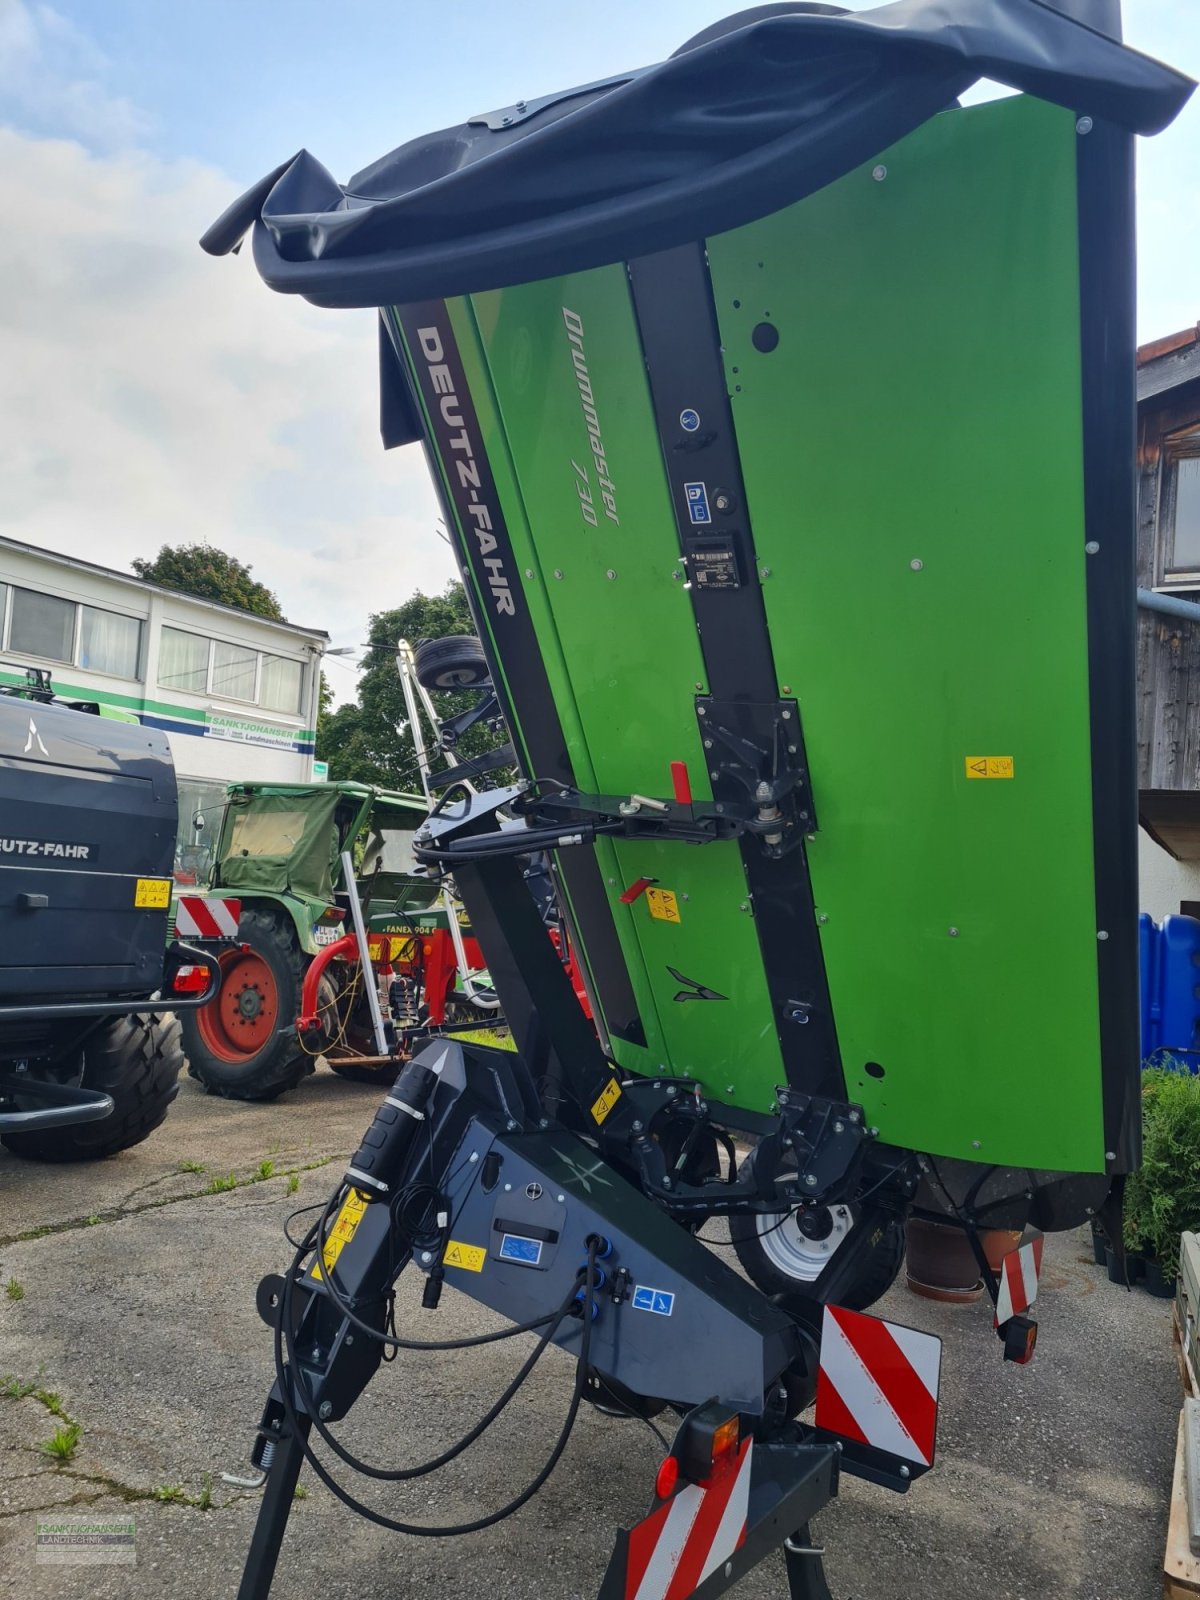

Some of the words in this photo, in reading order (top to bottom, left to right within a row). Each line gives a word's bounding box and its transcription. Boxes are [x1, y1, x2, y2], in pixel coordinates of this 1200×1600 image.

[562, 306, 619, 528] Drummaster
[417, 326, 516, 616] DEUTZ-FAHR
[571, 459, 599, 527] 730
[212, 717, 293, 738] SANKTJOHANSER
[245, 734, 291, 747] Landmaschinen
[0, 839, 90, 859] UTZ-FAHR
[387, 925, 412, 934] FANEX
[415, 926, 430, 935] 904
